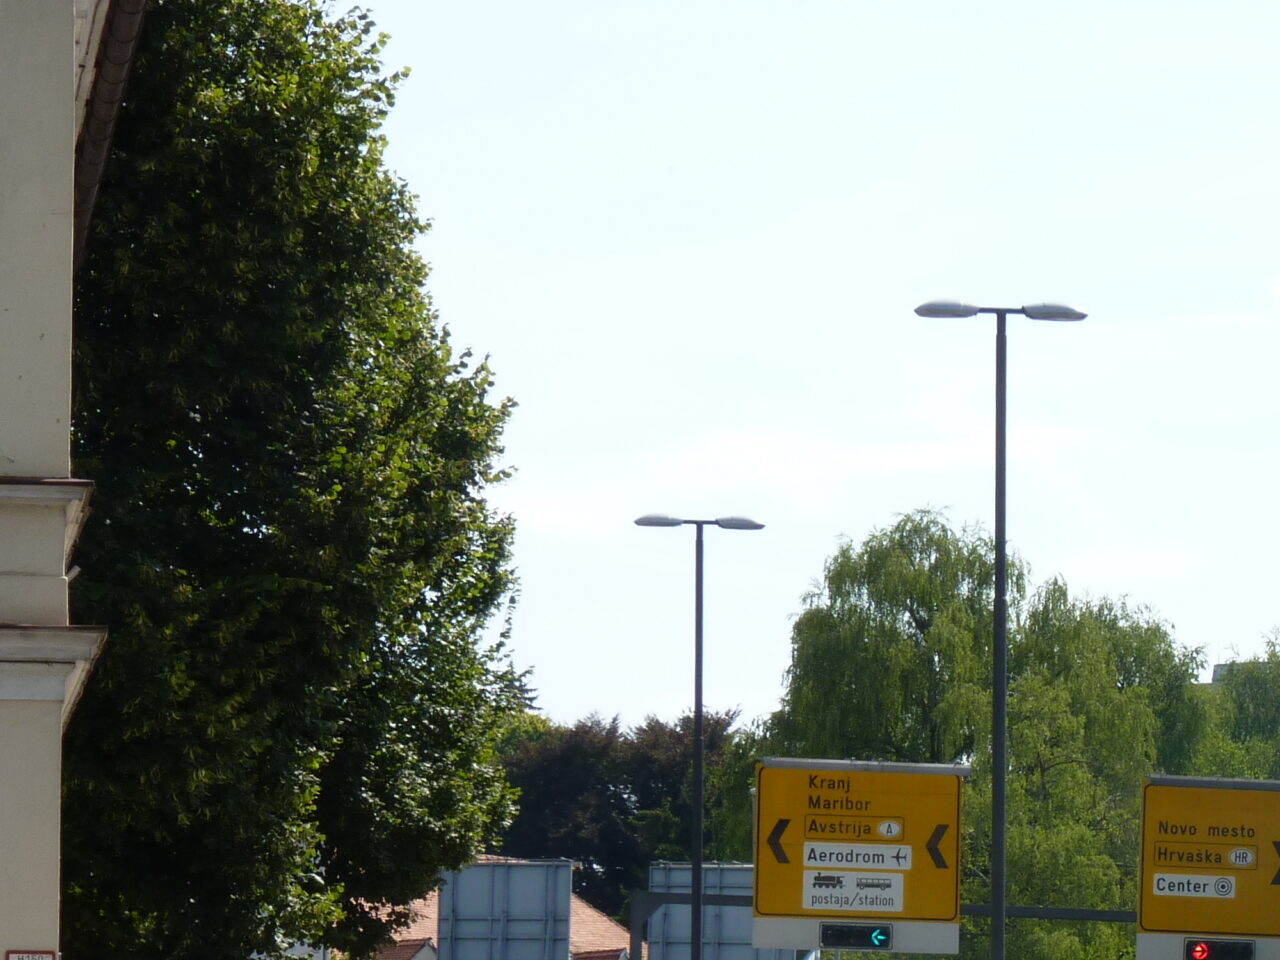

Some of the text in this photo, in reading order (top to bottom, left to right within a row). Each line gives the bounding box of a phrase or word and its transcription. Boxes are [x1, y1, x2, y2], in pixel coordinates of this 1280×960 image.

[808, 775, 850, 792] Kranj
[808, 796, 872, 810] Maribor
[808, 819, 893, 837] Avstrija A
[1158, 821, 1255, 838] Novo mesto
[807, 847, 885, 864] Aerodrom
[1158, 847, 1248, 863] Hrvaška HR
[1156, 877, 1209, 893] Center
[811, 892, 894, 907] postaja/station
